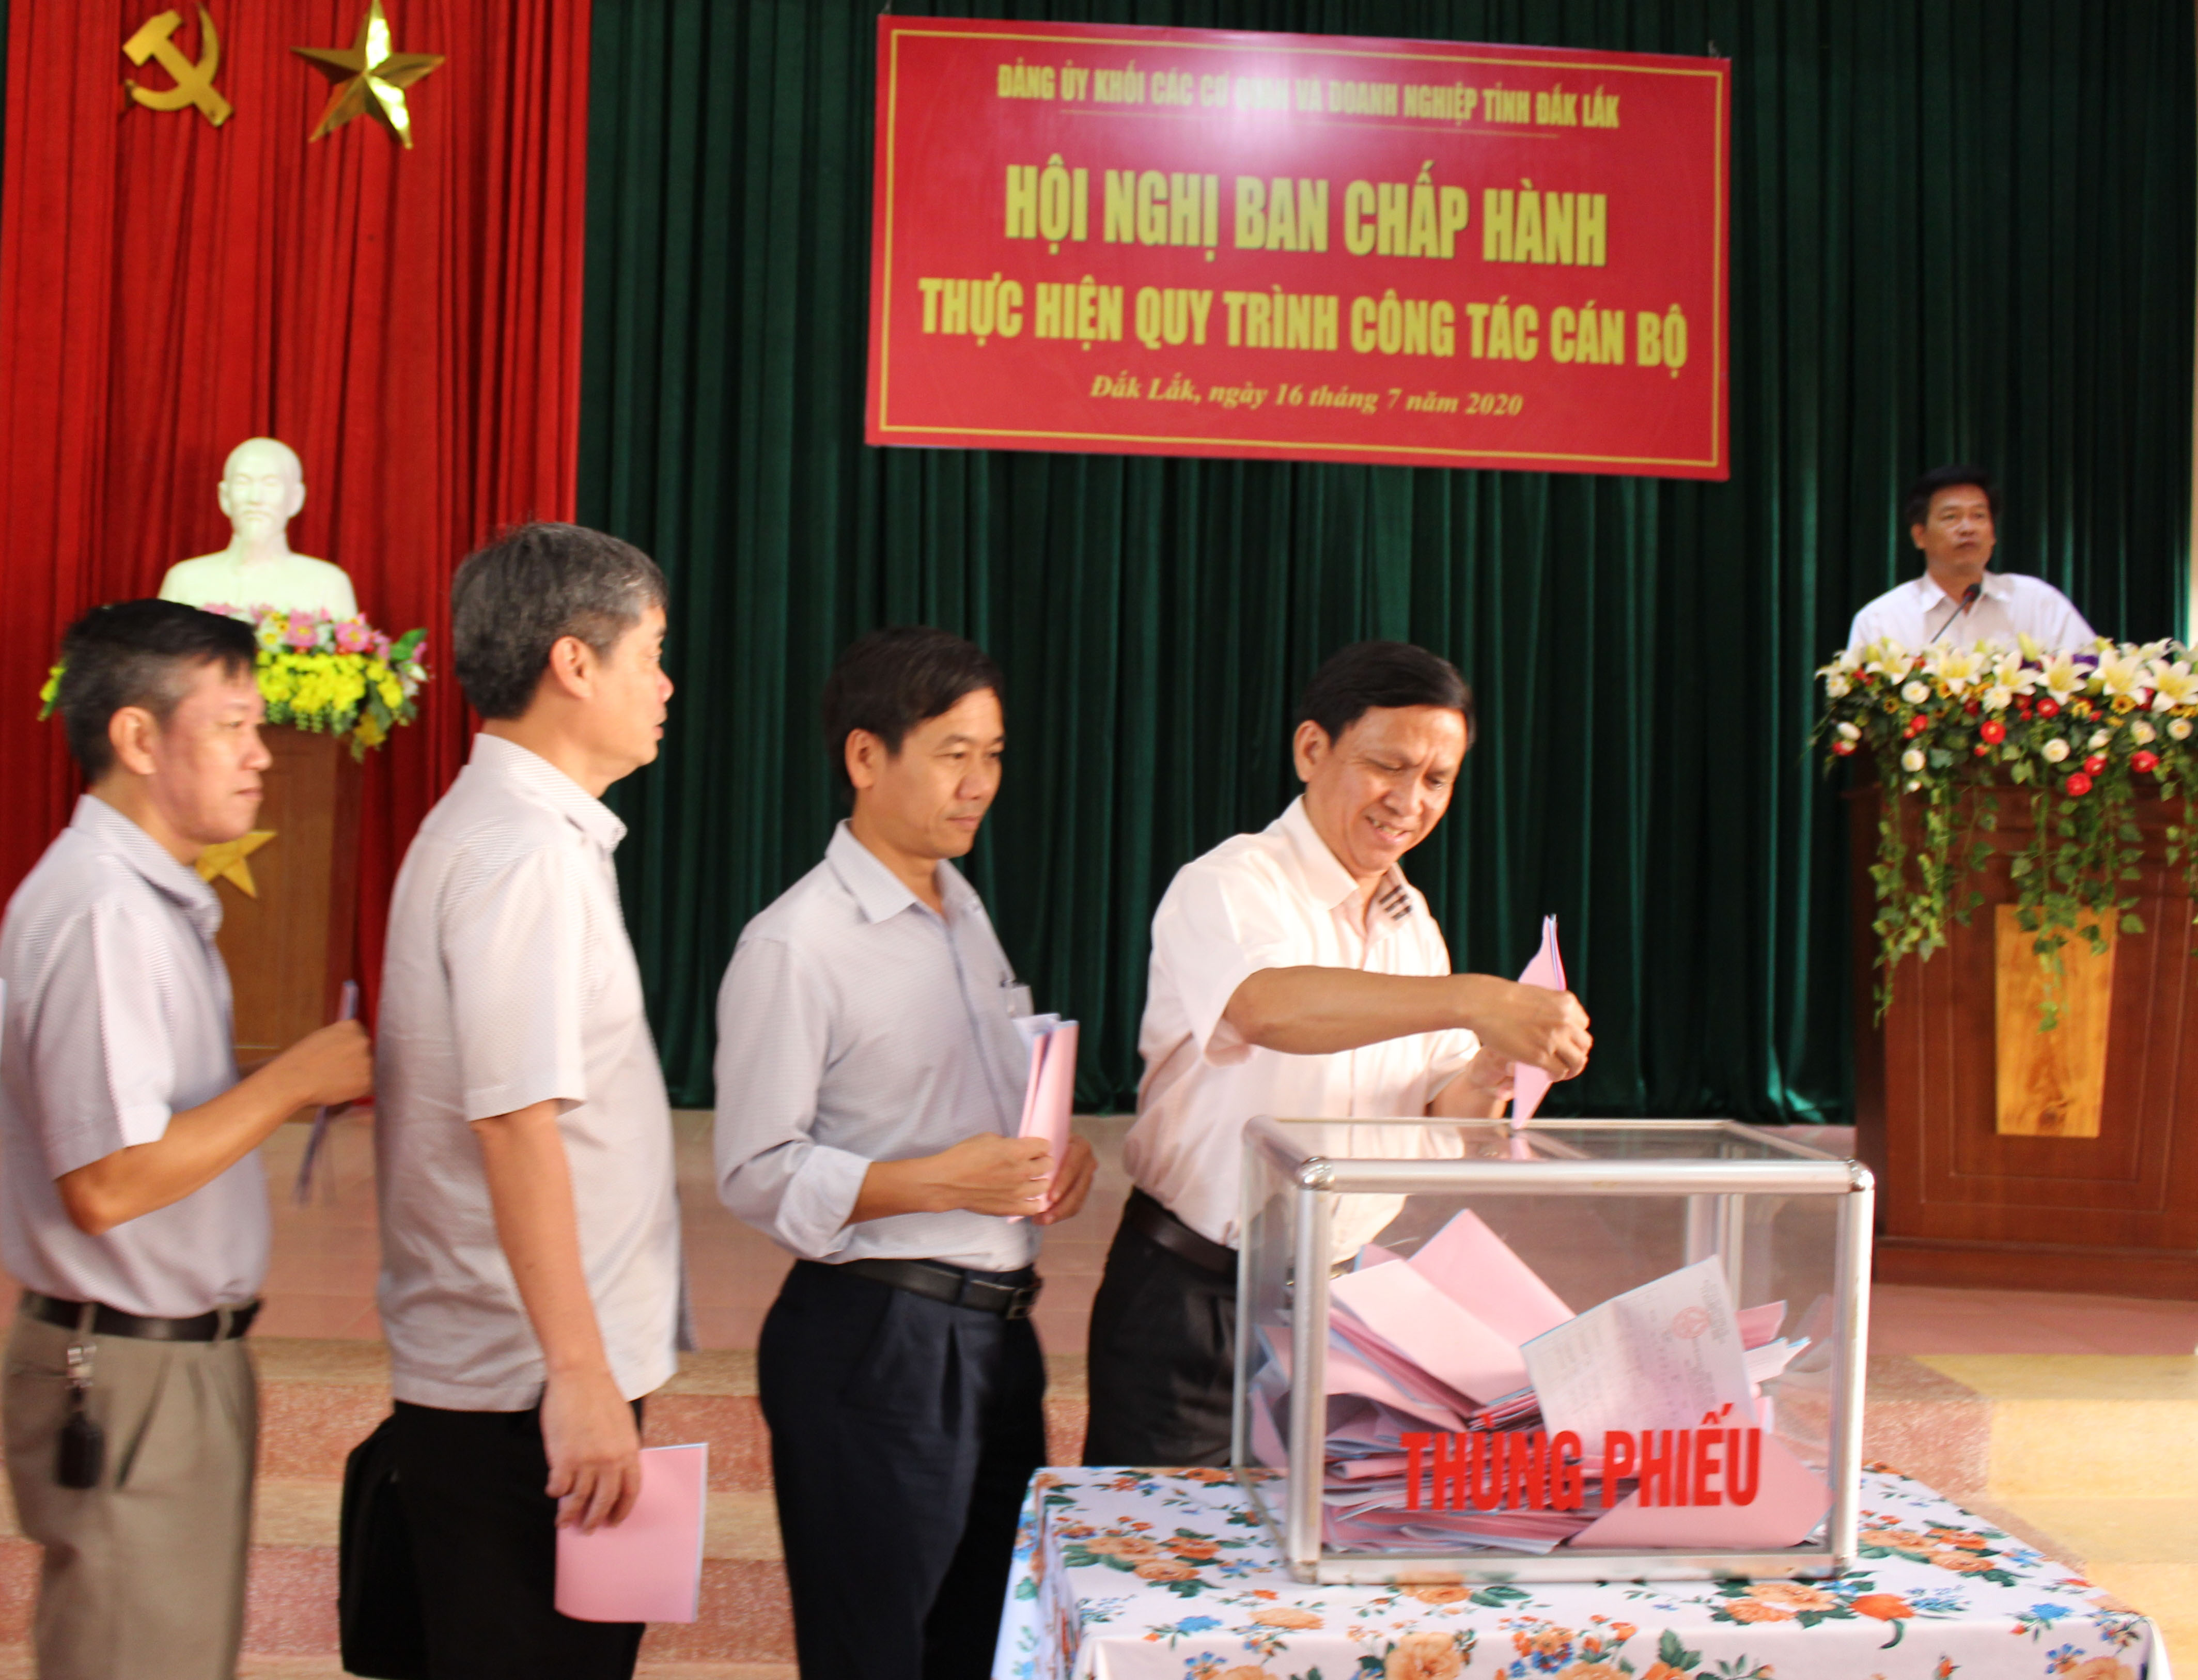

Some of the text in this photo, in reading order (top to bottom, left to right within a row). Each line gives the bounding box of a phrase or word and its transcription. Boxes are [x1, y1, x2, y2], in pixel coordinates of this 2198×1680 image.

[1093, 59, 1145, 104] KHỐI
[1151, 67, 1193, 106] CÁC
[1201, 70, 1229, 107] CƠ
[1328, 80, 1398, 117] DOANH
[1404, 81, 1477, 127] NGHIỆP
[1005, 153, 1607, 267] HỘI NGHỊ BAN CHẤP HÀNH
[919, 272, 1687, 379] THỰC HIỆN QUY TRÌNH CÔNG TÁC CÁN BỘ
[1208, 381, 1269, 410] ngày
[1275, 383, 1303, 407] 16
[1308, 385, 1379, 415] tháng
[1386, 387, 1402, 410] 7
[1405, 391, 1459, 414] năm
[1465, 392, 1523, 416] 2020
[1401, 1403, 1763, 1511] THÙNG PHIẾU
